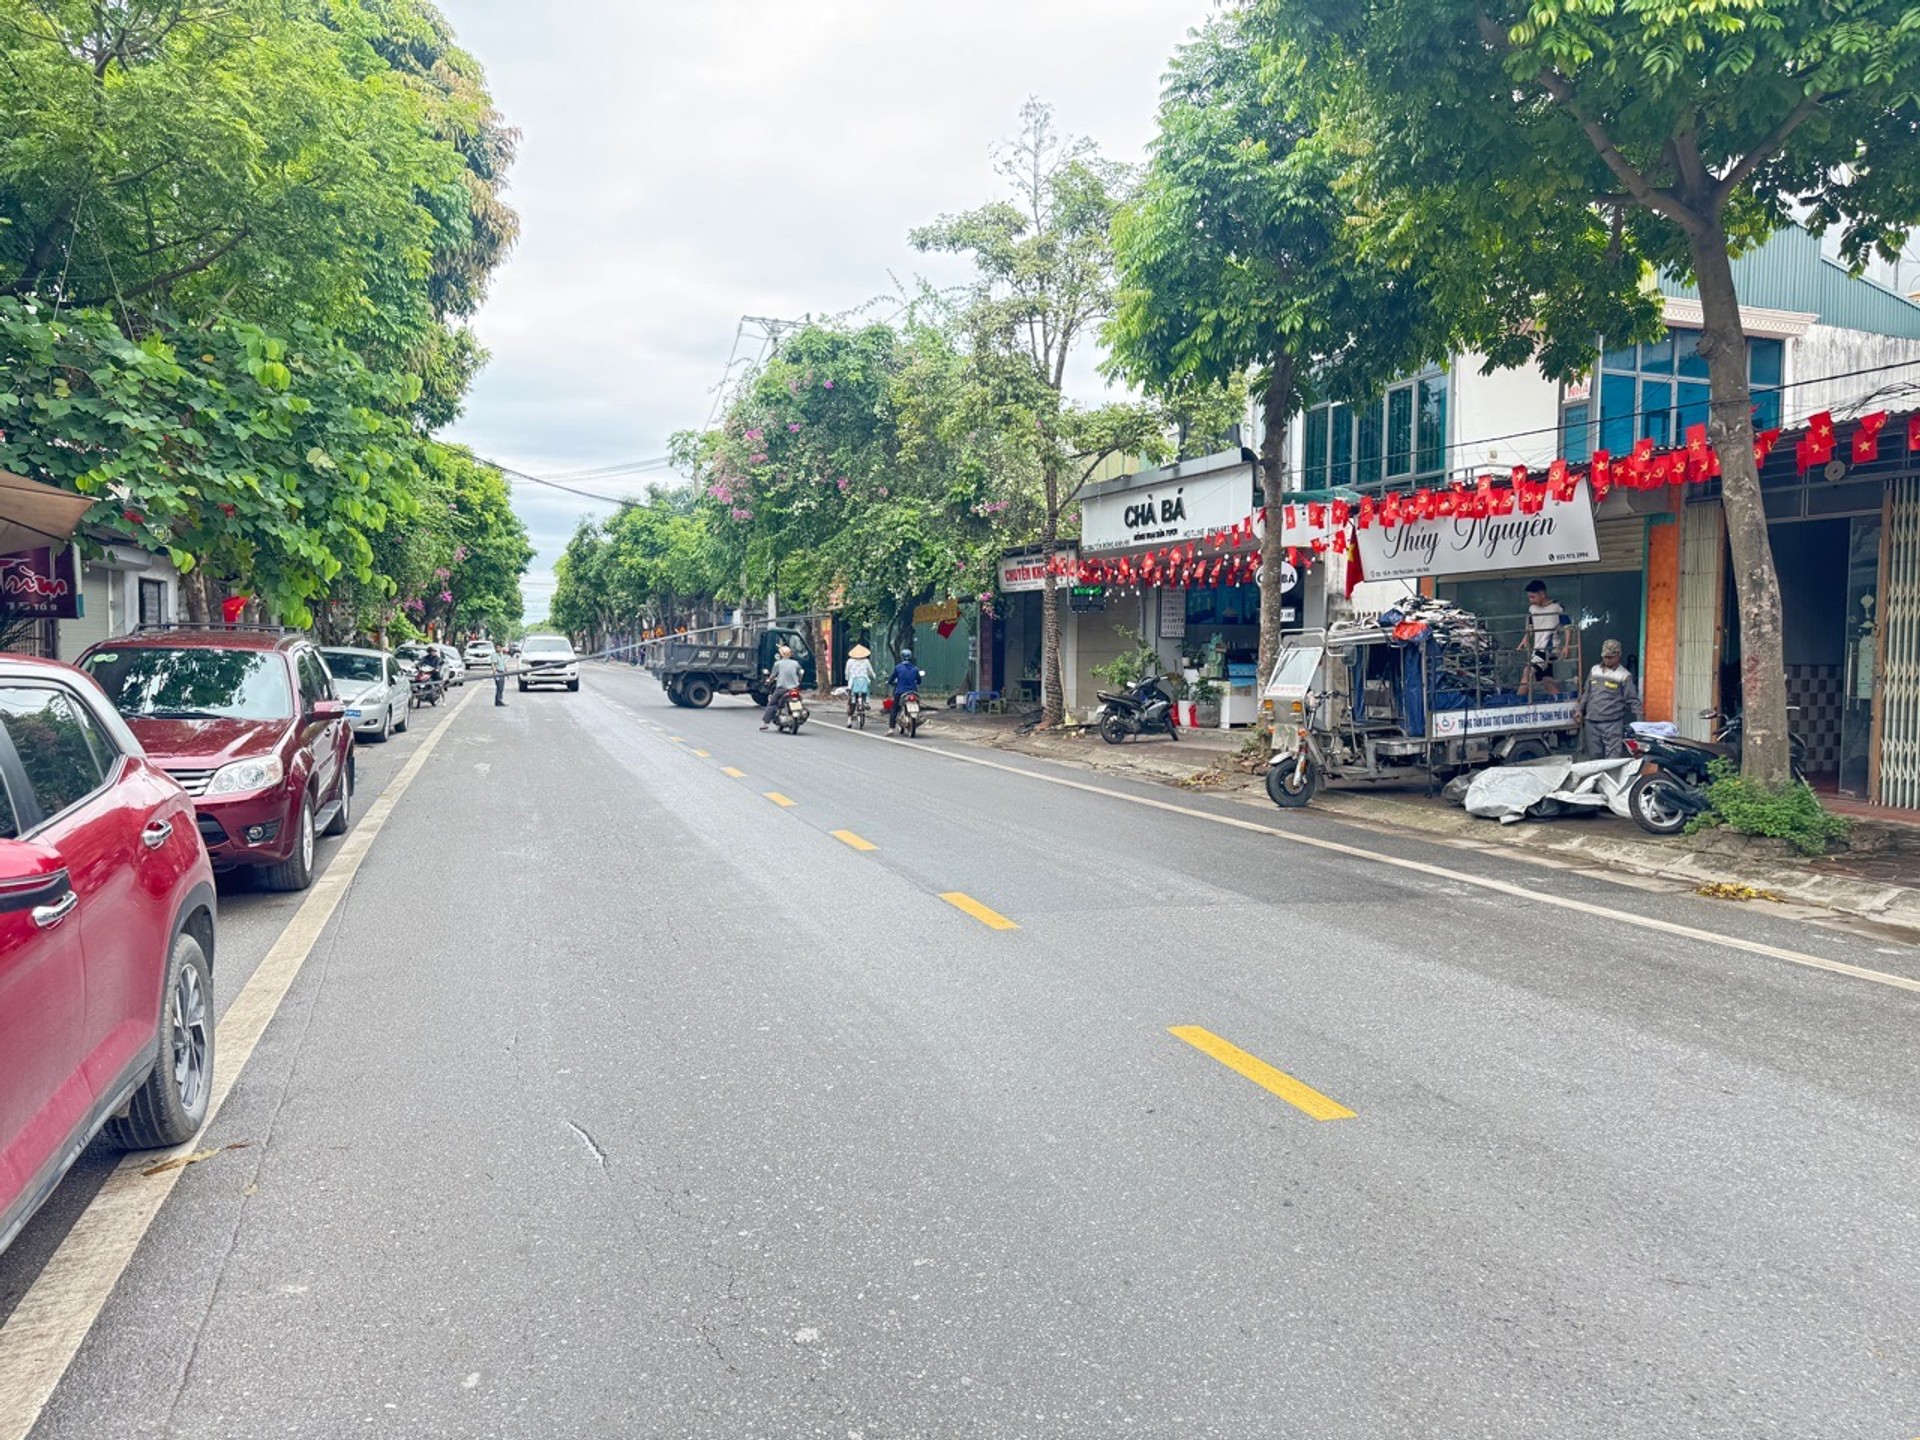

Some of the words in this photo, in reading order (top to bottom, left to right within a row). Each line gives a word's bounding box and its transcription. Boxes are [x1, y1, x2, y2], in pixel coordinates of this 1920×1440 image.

[1124, 493, 1157, 529] CHÀ
[1161, 487, 1186, 524] BÁ
[1383, 524, 1441, 564] Thúy
[1458, 718, 1472, 729] TRNG
